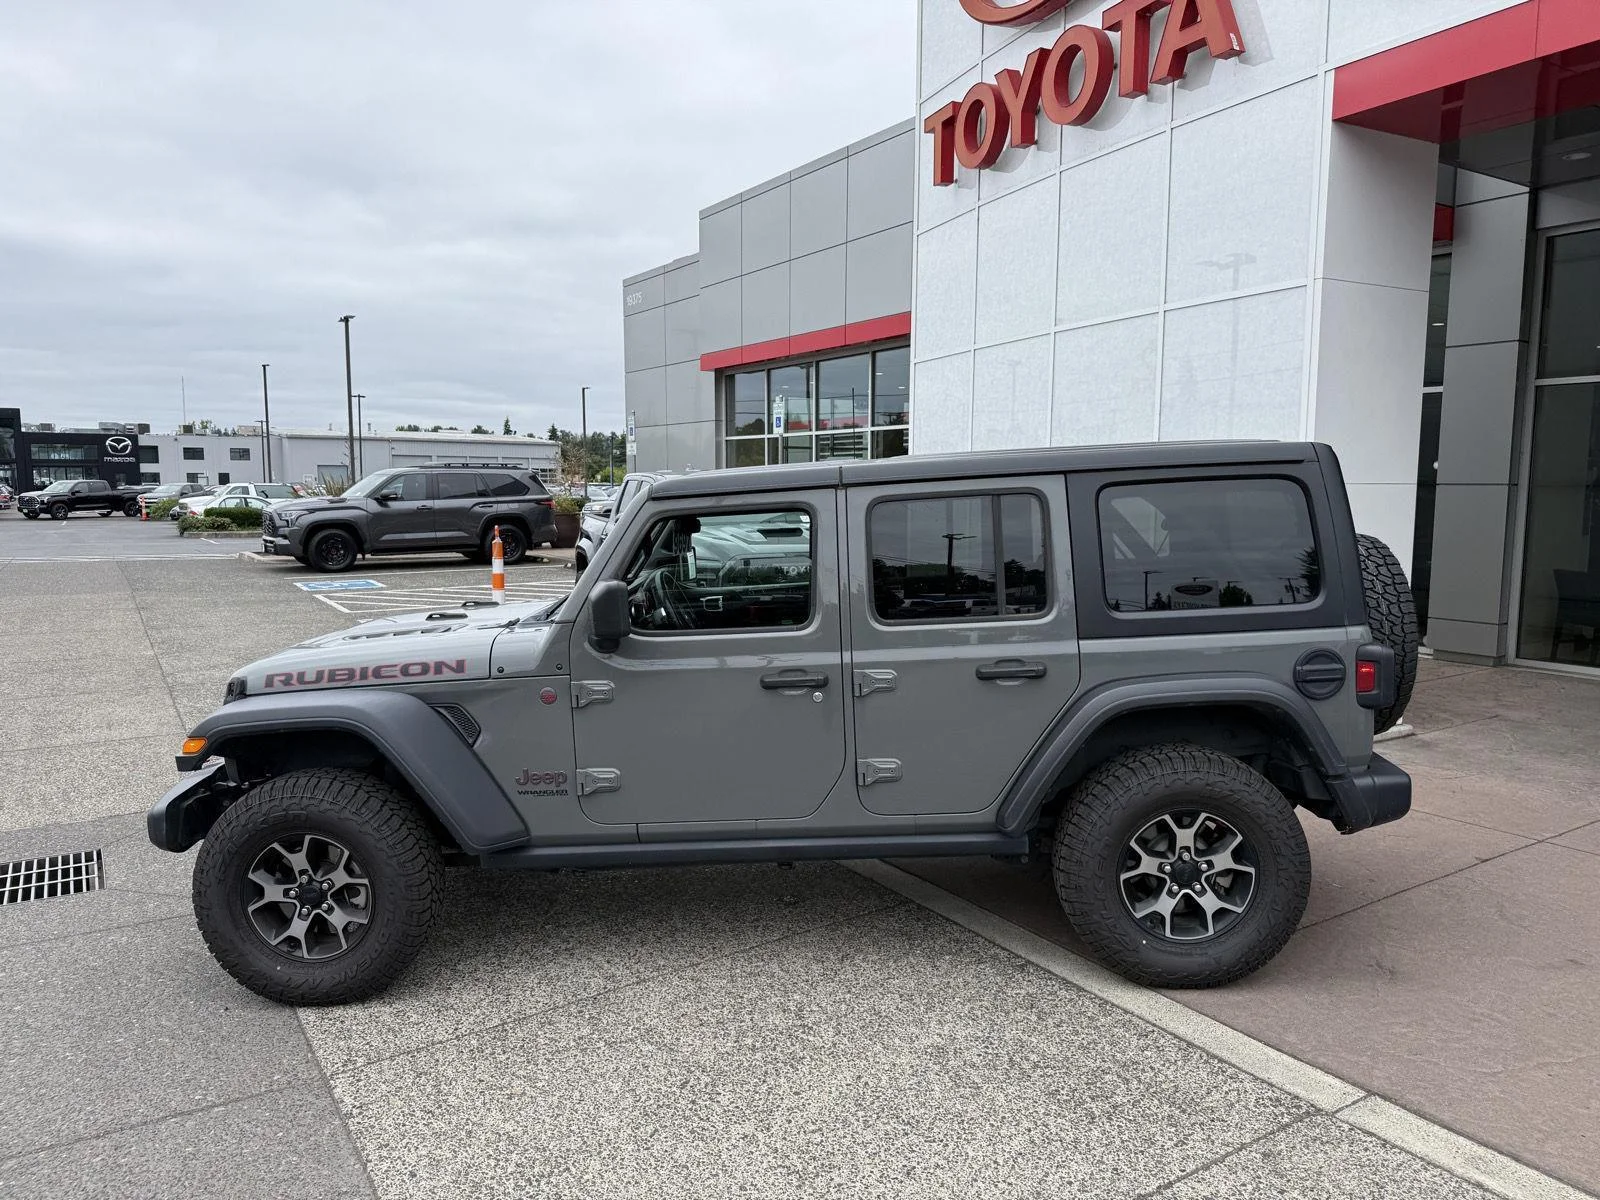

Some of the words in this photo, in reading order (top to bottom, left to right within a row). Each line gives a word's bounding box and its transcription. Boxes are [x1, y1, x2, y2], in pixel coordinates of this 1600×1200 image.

[924, 0, 1246, 187] TOYOTA
[263, 658, 467, 689] RUBICON
[515, 767, 568, 787] Jeep
